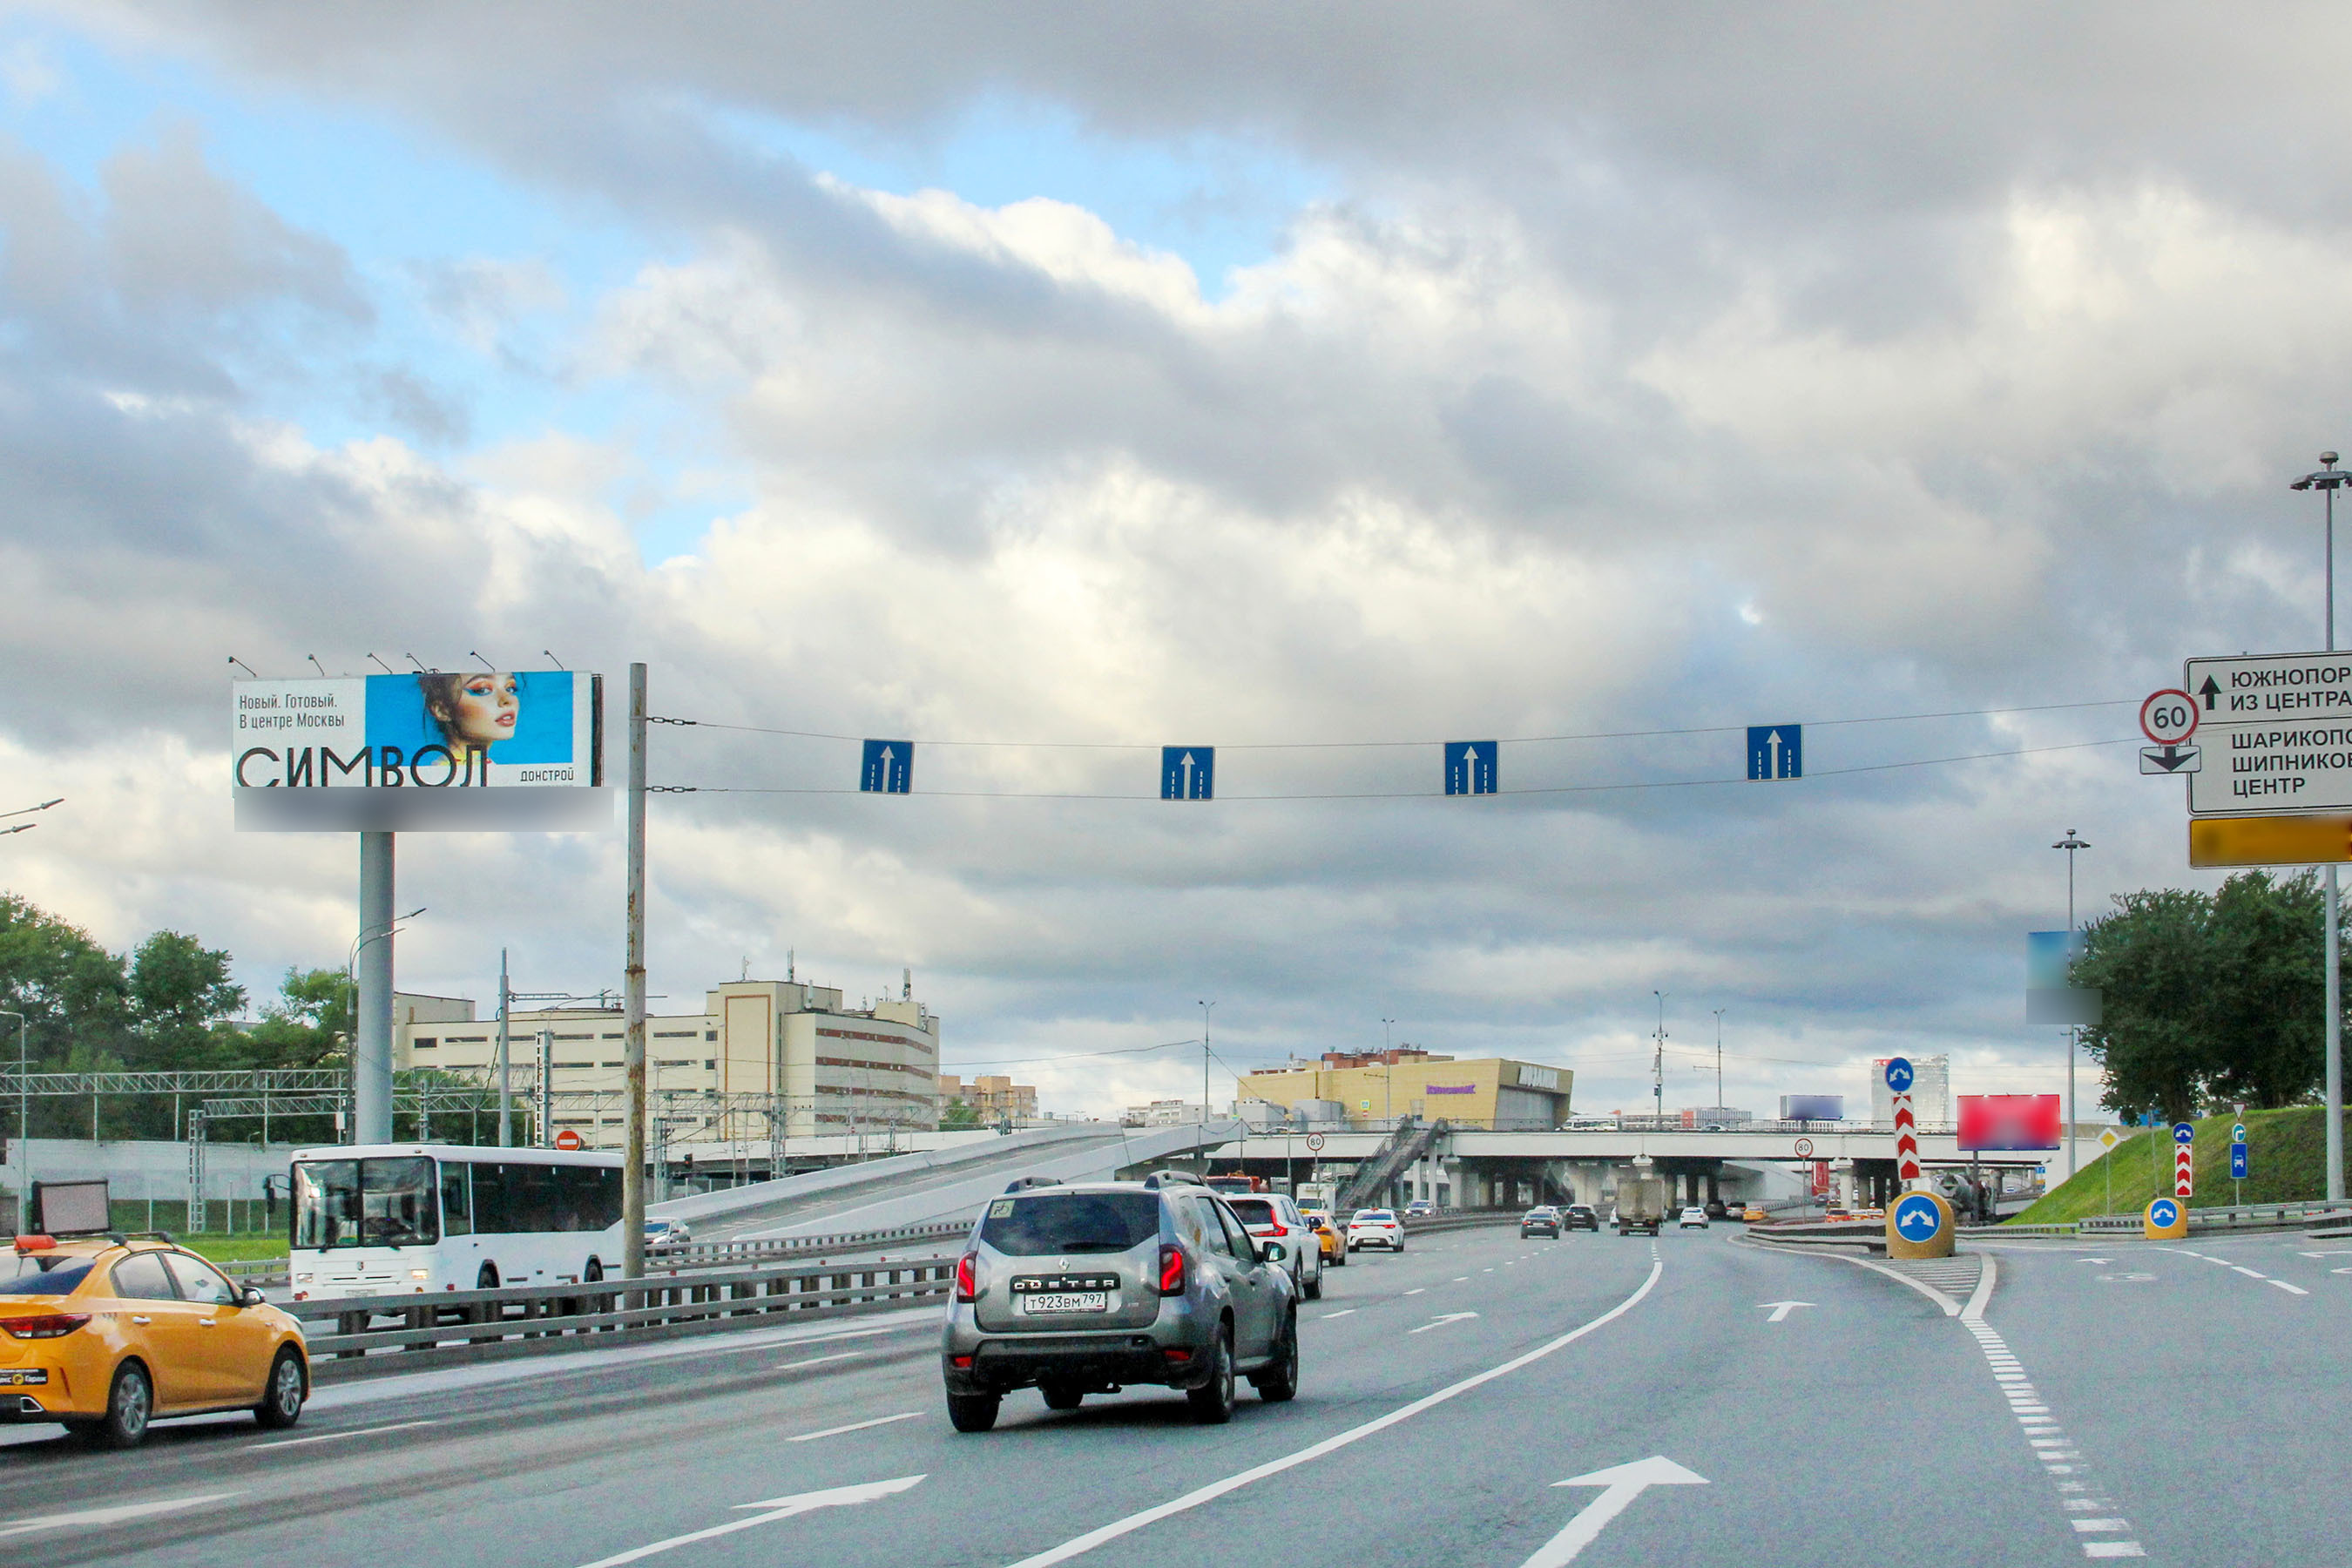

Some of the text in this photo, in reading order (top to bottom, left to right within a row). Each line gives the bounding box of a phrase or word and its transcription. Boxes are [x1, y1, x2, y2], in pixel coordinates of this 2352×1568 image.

[2232, 667, 2351, 688] ЮЖНОПОР
[240, 693, 338, 709] Новый. Готовый.
[2231, 690, 2352, 713] ИЗ ЦЕНТРА
[240, 712, 345, 731] В центре Москвы
[2153, 706, 2186, 729] 60
[236, 744, 489, 787] СИМВОЛ
[520, 767, 574, 782] ДОНСТРОЙ
[2233, 777, 2306, 799] ЦЕНТР
[1798, 1143, 1809, 1152] 80
